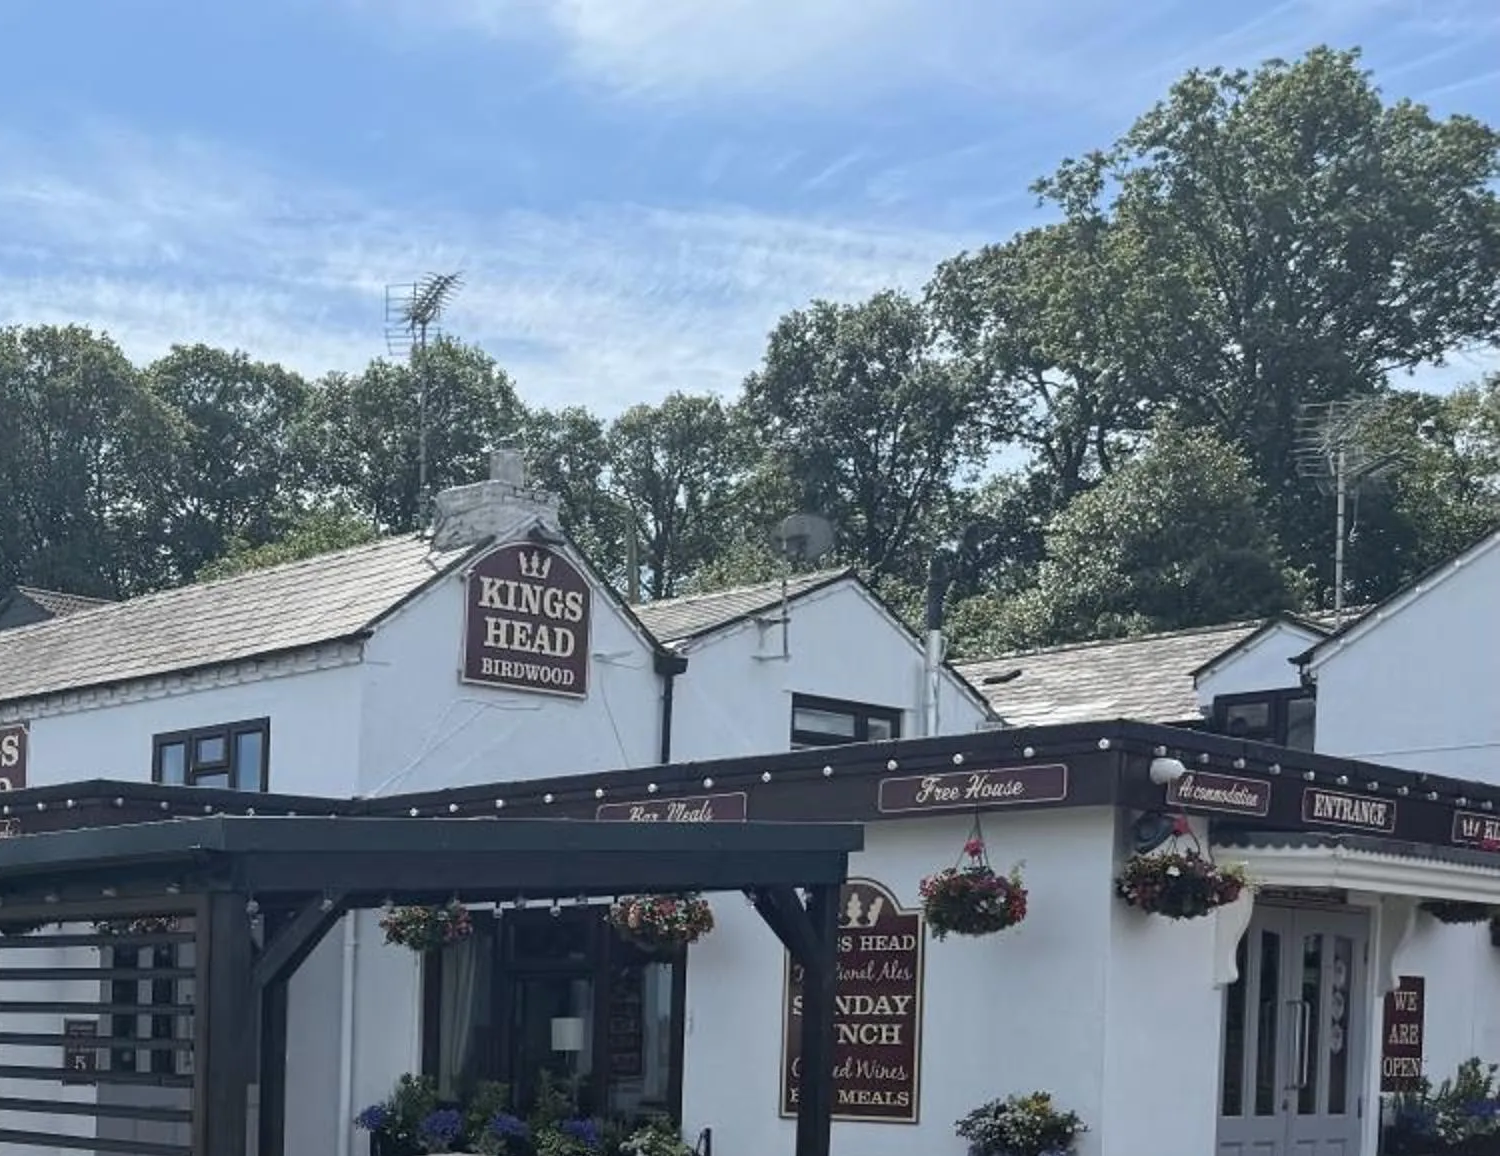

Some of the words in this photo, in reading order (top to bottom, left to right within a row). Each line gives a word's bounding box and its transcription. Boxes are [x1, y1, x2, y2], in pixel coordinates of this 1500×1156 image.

[478, 576, 583, 622] KINGS
[484, 616, 575, 657] HEAD
[481, 657, 575, 685] BIRDWOOD
[915, 775, 960, 803] Free
[964, 774, 1026, 799] House
[1313, 794, 1387, 826] ENTRANCE
[860, 935, 916, 951] HEAD
[878, 959, 913, 981] Ales
[792, 995, 913, 1015] SNDAY
[1394, 991, 1417, 1012] WE
[834, 1023, 903, 1045] NCH
[1388, 1024, 1419, 1044] ARE
[855, 1058, 910, 1081] Wines
[1383, 1058, 1421, 1077] OPEN
[838, 1089, 910, 1106] MEALS
